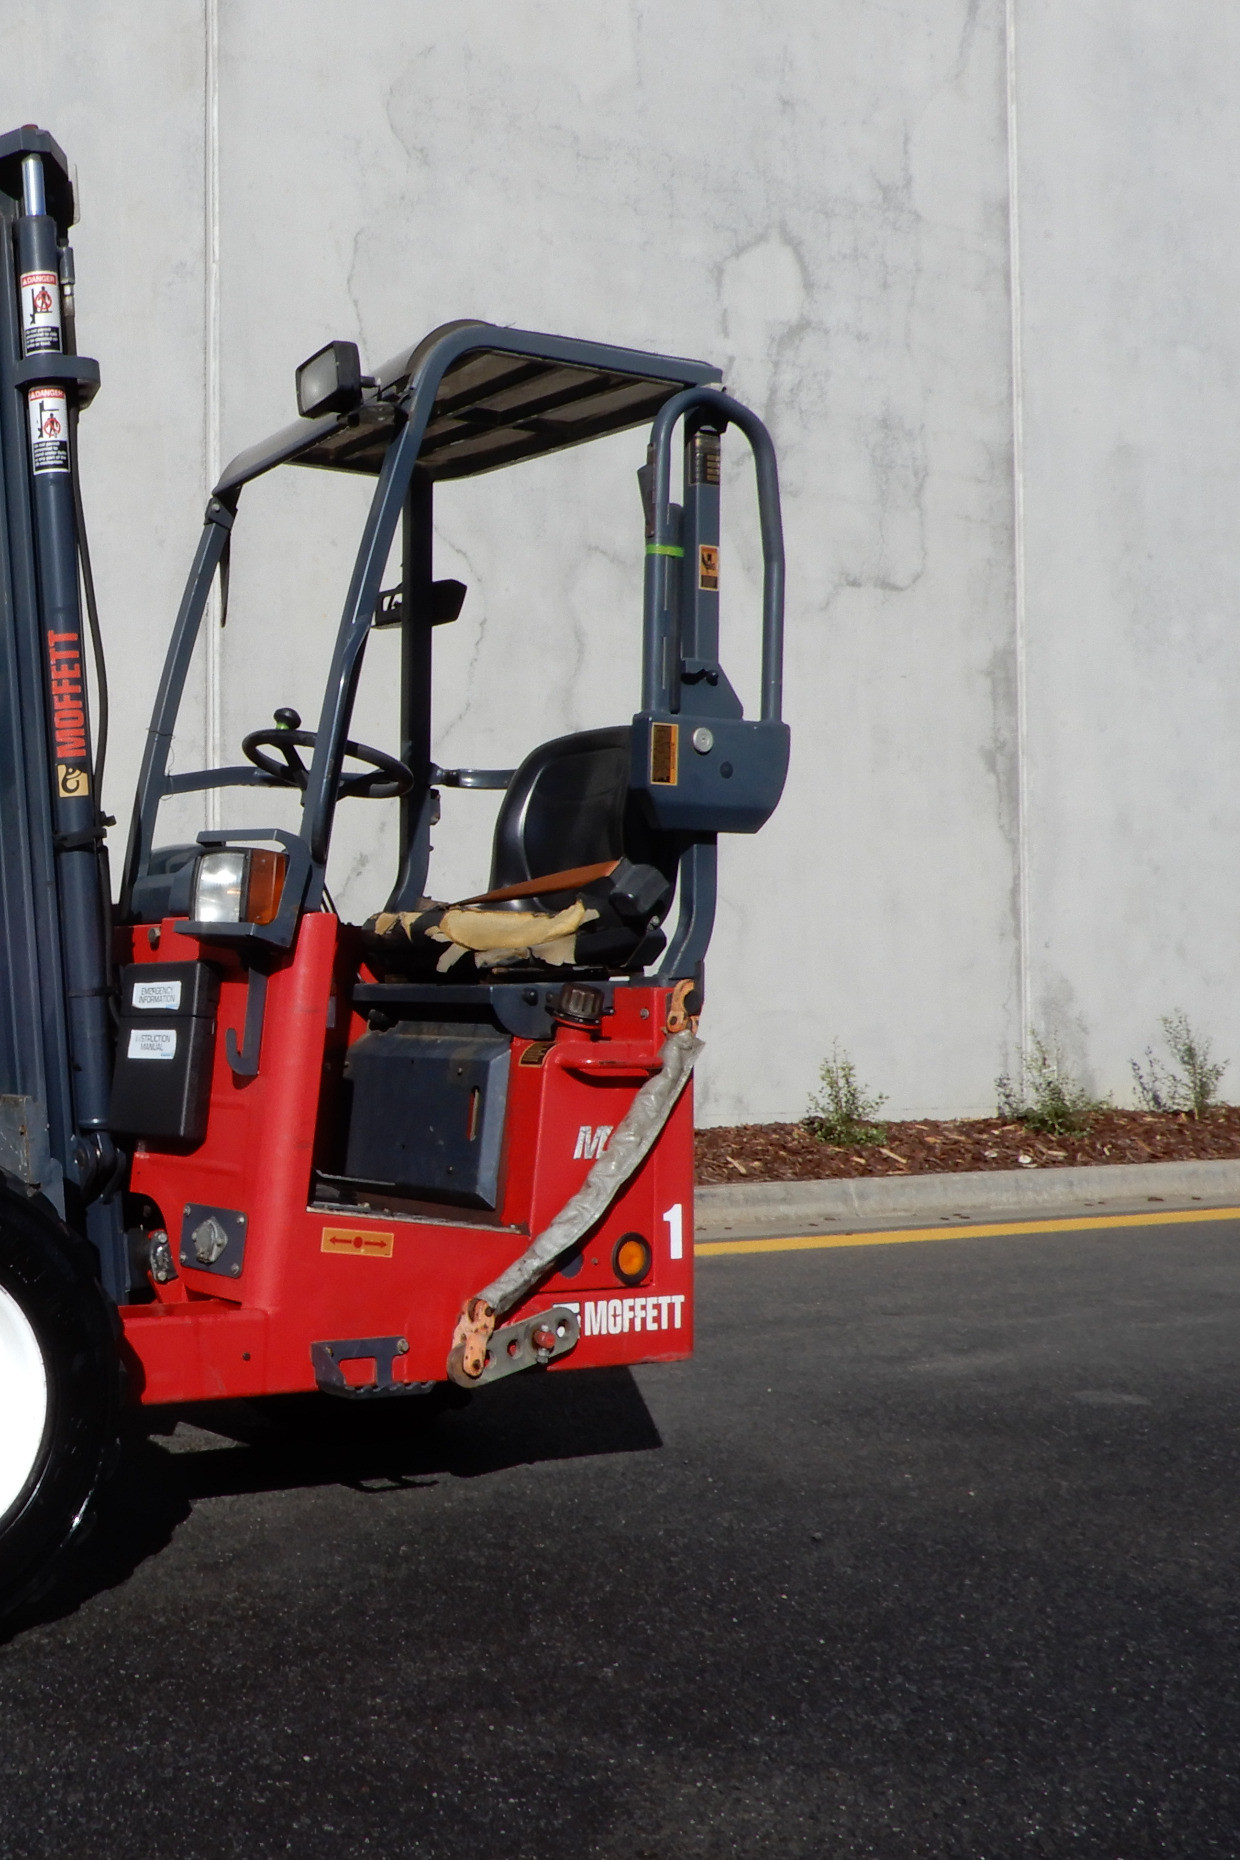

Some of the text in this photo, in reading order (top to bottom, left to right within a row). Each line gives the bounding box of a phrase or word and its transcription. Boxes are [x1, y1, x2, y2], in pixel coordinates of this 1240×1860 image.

[47, 629, 86, 758] MOFFETT
[138, 994, 175, 1004] INFORMATION
[141, 986, 173, 996] EMERGENCY
[663, 1203, 683, 1260] 1
[584, 1294, 685, 1337] MOFFETT
